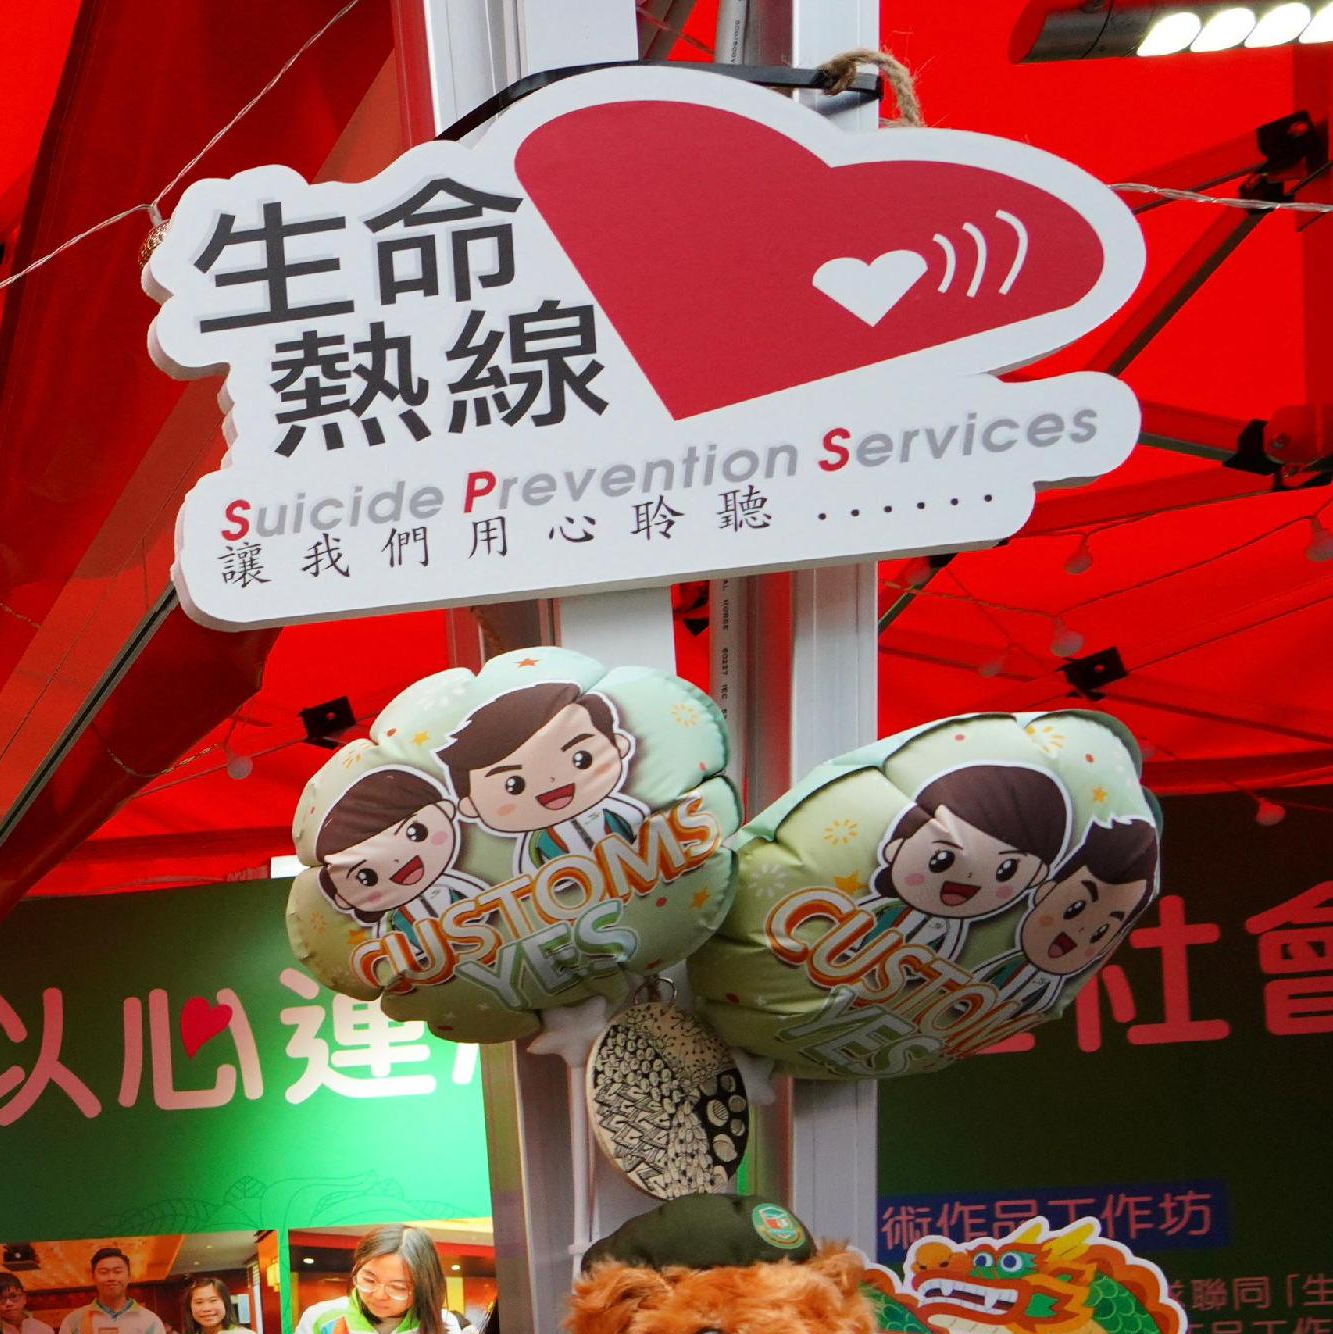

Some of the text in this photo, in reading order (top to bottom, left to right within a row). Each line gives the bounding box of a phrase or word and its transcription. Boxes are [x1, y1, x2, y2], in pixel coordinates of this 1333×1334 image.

[193, 177, 523, 334] 生命
[270, 299, 610, 458] 熱線
[220, 402, 1101, 543] Suicide Prevention Services
[350, 795, 725, 996] CUSTOMS
[456, 898, 642, 1012] YES
